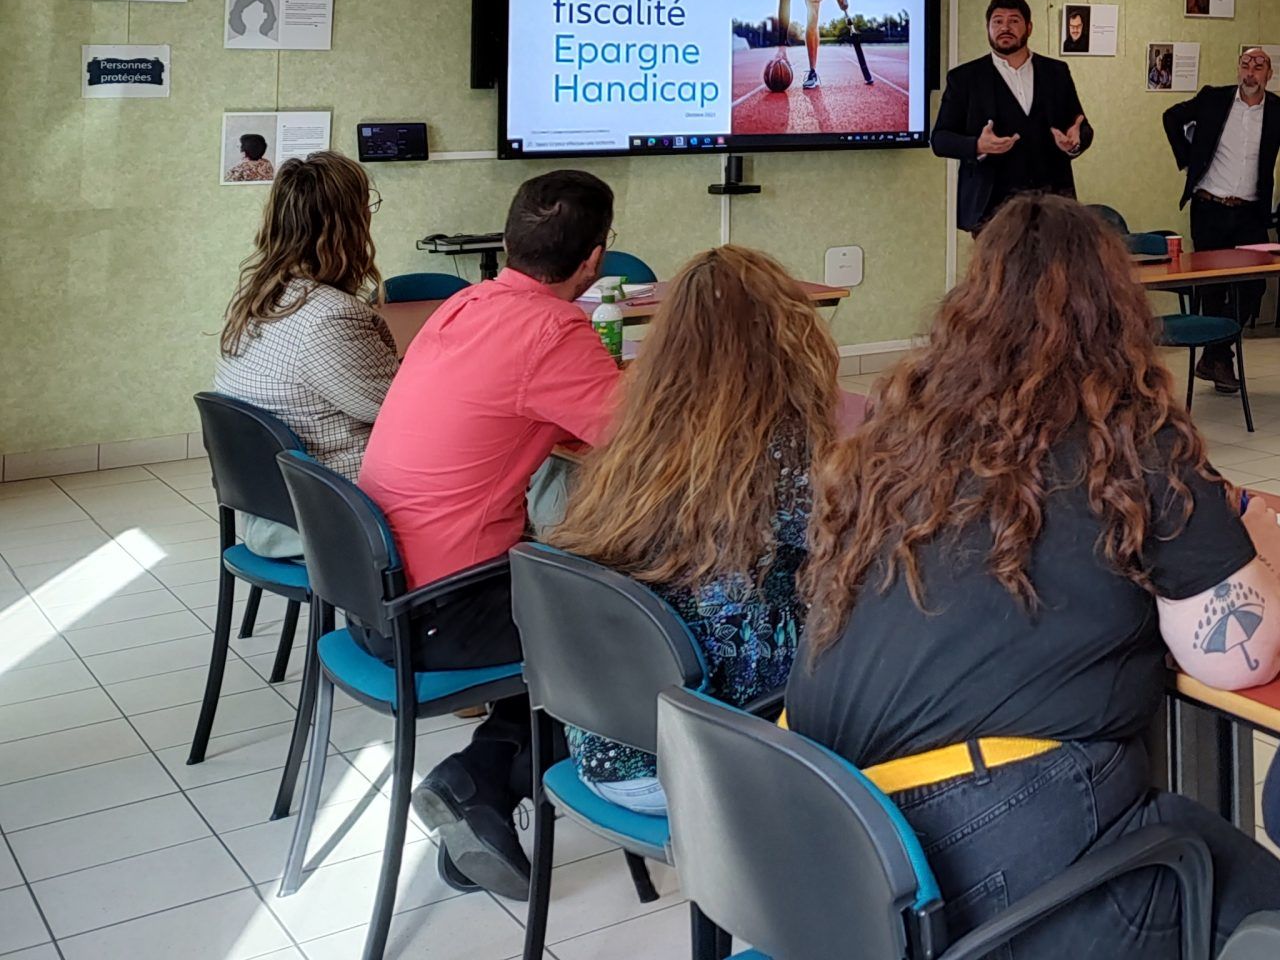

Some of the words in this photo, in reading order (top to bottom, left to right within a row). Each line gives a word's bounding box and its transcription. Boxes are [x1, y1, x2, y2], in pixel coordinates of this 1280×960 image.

[555, 34, 700, 71] Epargne
[100, 61, 152, 69] Personnes
[101, 73, 152, 83] protégées
[554, 73, 719, 108] Handicap
